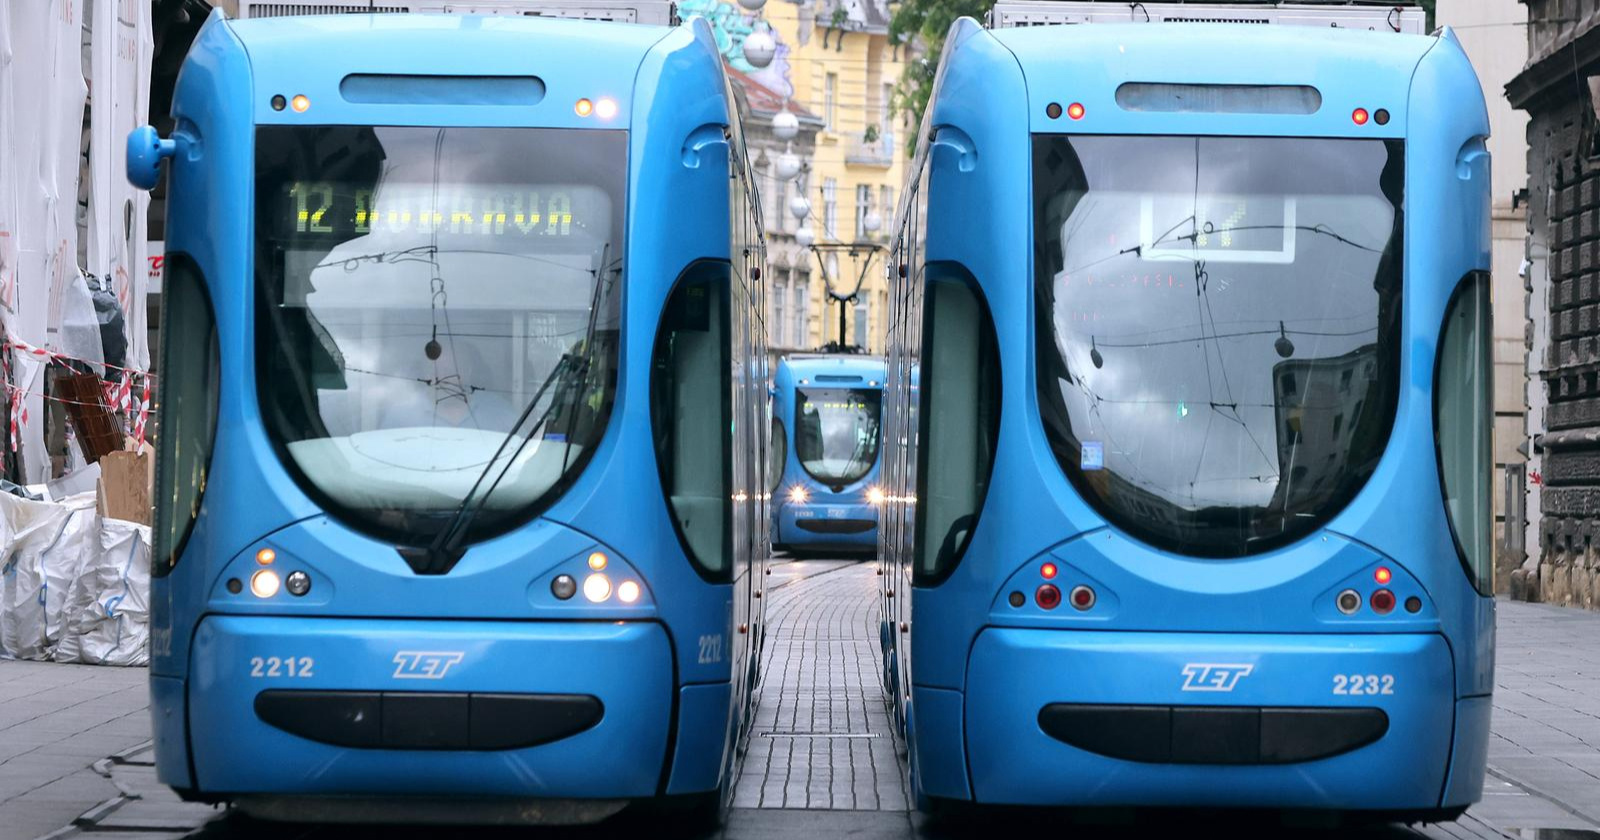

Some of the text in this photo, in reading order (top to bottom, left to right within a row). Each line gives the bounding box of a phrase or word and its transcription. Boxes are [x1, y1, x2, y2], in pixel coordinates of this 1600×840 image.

[293, 183, 333, 233] 12
[698, 633, 722, 664] 2212
[250, 656, 314, 678] 2212
[392, 651, 465, 680] ZET
[1181, 663, 1254, 691] ZET
[1332, 674, 1395, 695] 2232
